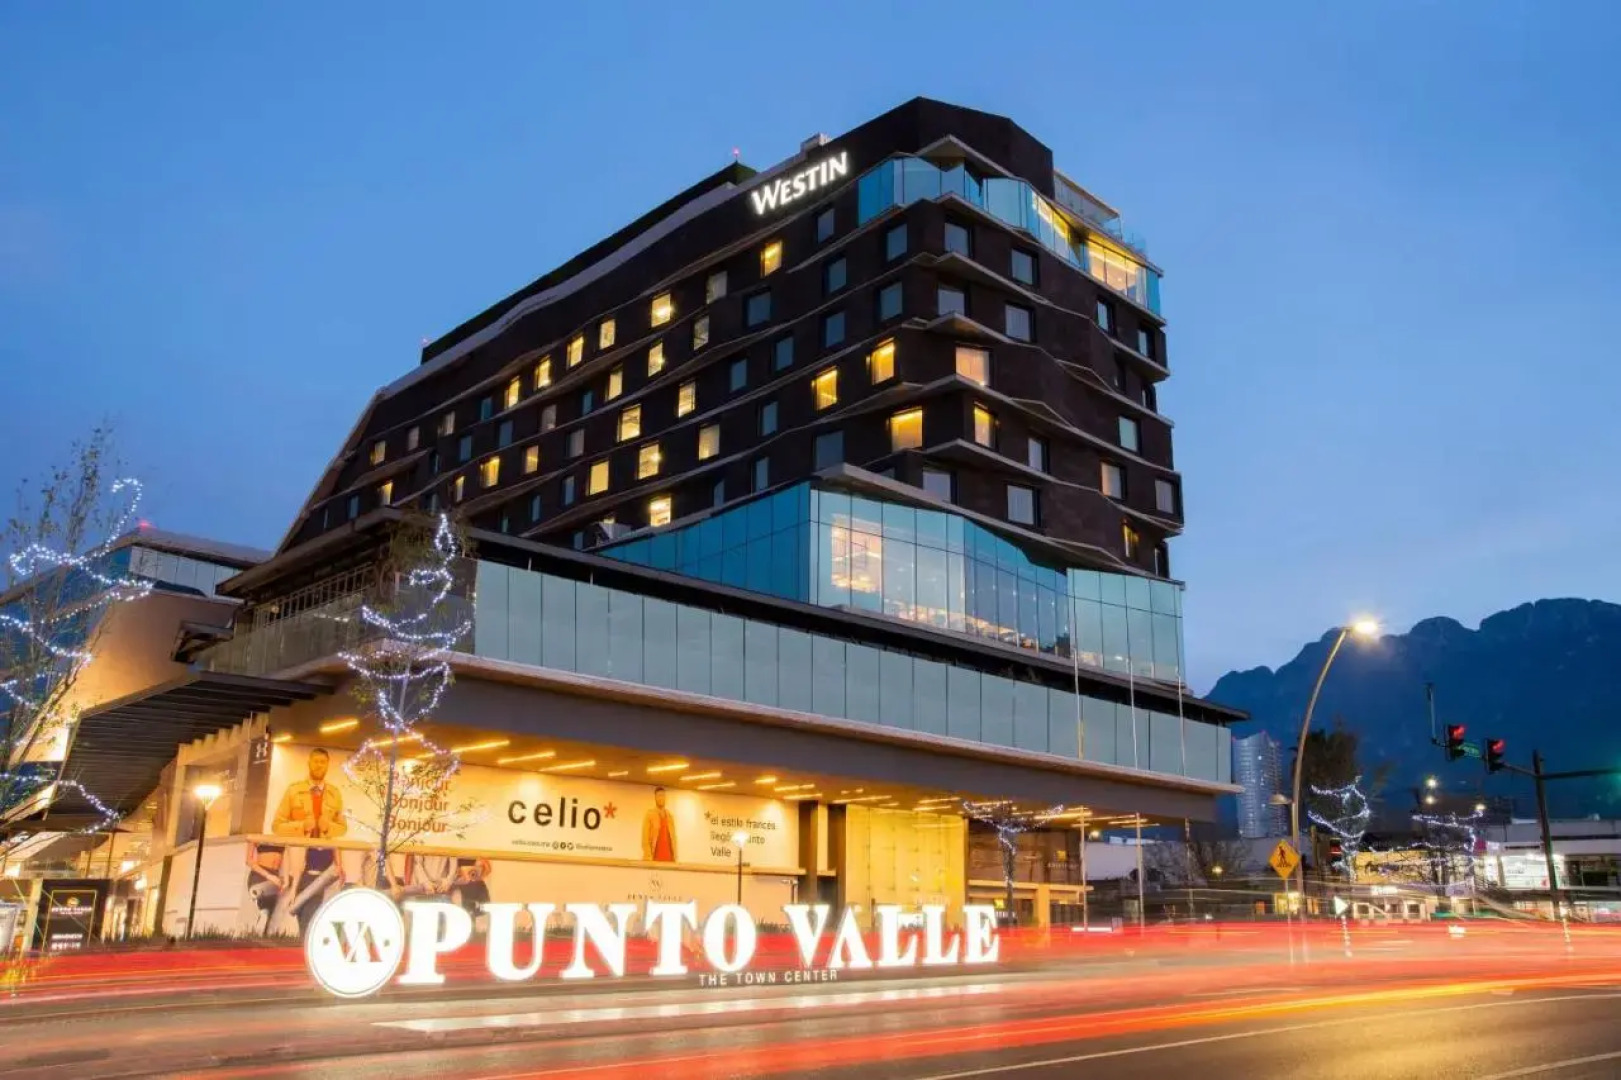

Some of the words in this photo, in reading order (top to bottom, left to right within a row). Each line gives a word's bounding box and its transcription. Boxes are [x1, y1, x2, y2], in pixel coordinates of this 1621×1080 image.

[751, 152, 848, 215] WESTIN
[710, 846, 731, 857] Valle
[396, 899, 758, 985] PUNTO
[785, 903, 1001, 970] VALLE
[698, 973, 728, 987] THE
[736, 971, 776, 984] TOWN
[784, 969, 838, 982] CENTER
